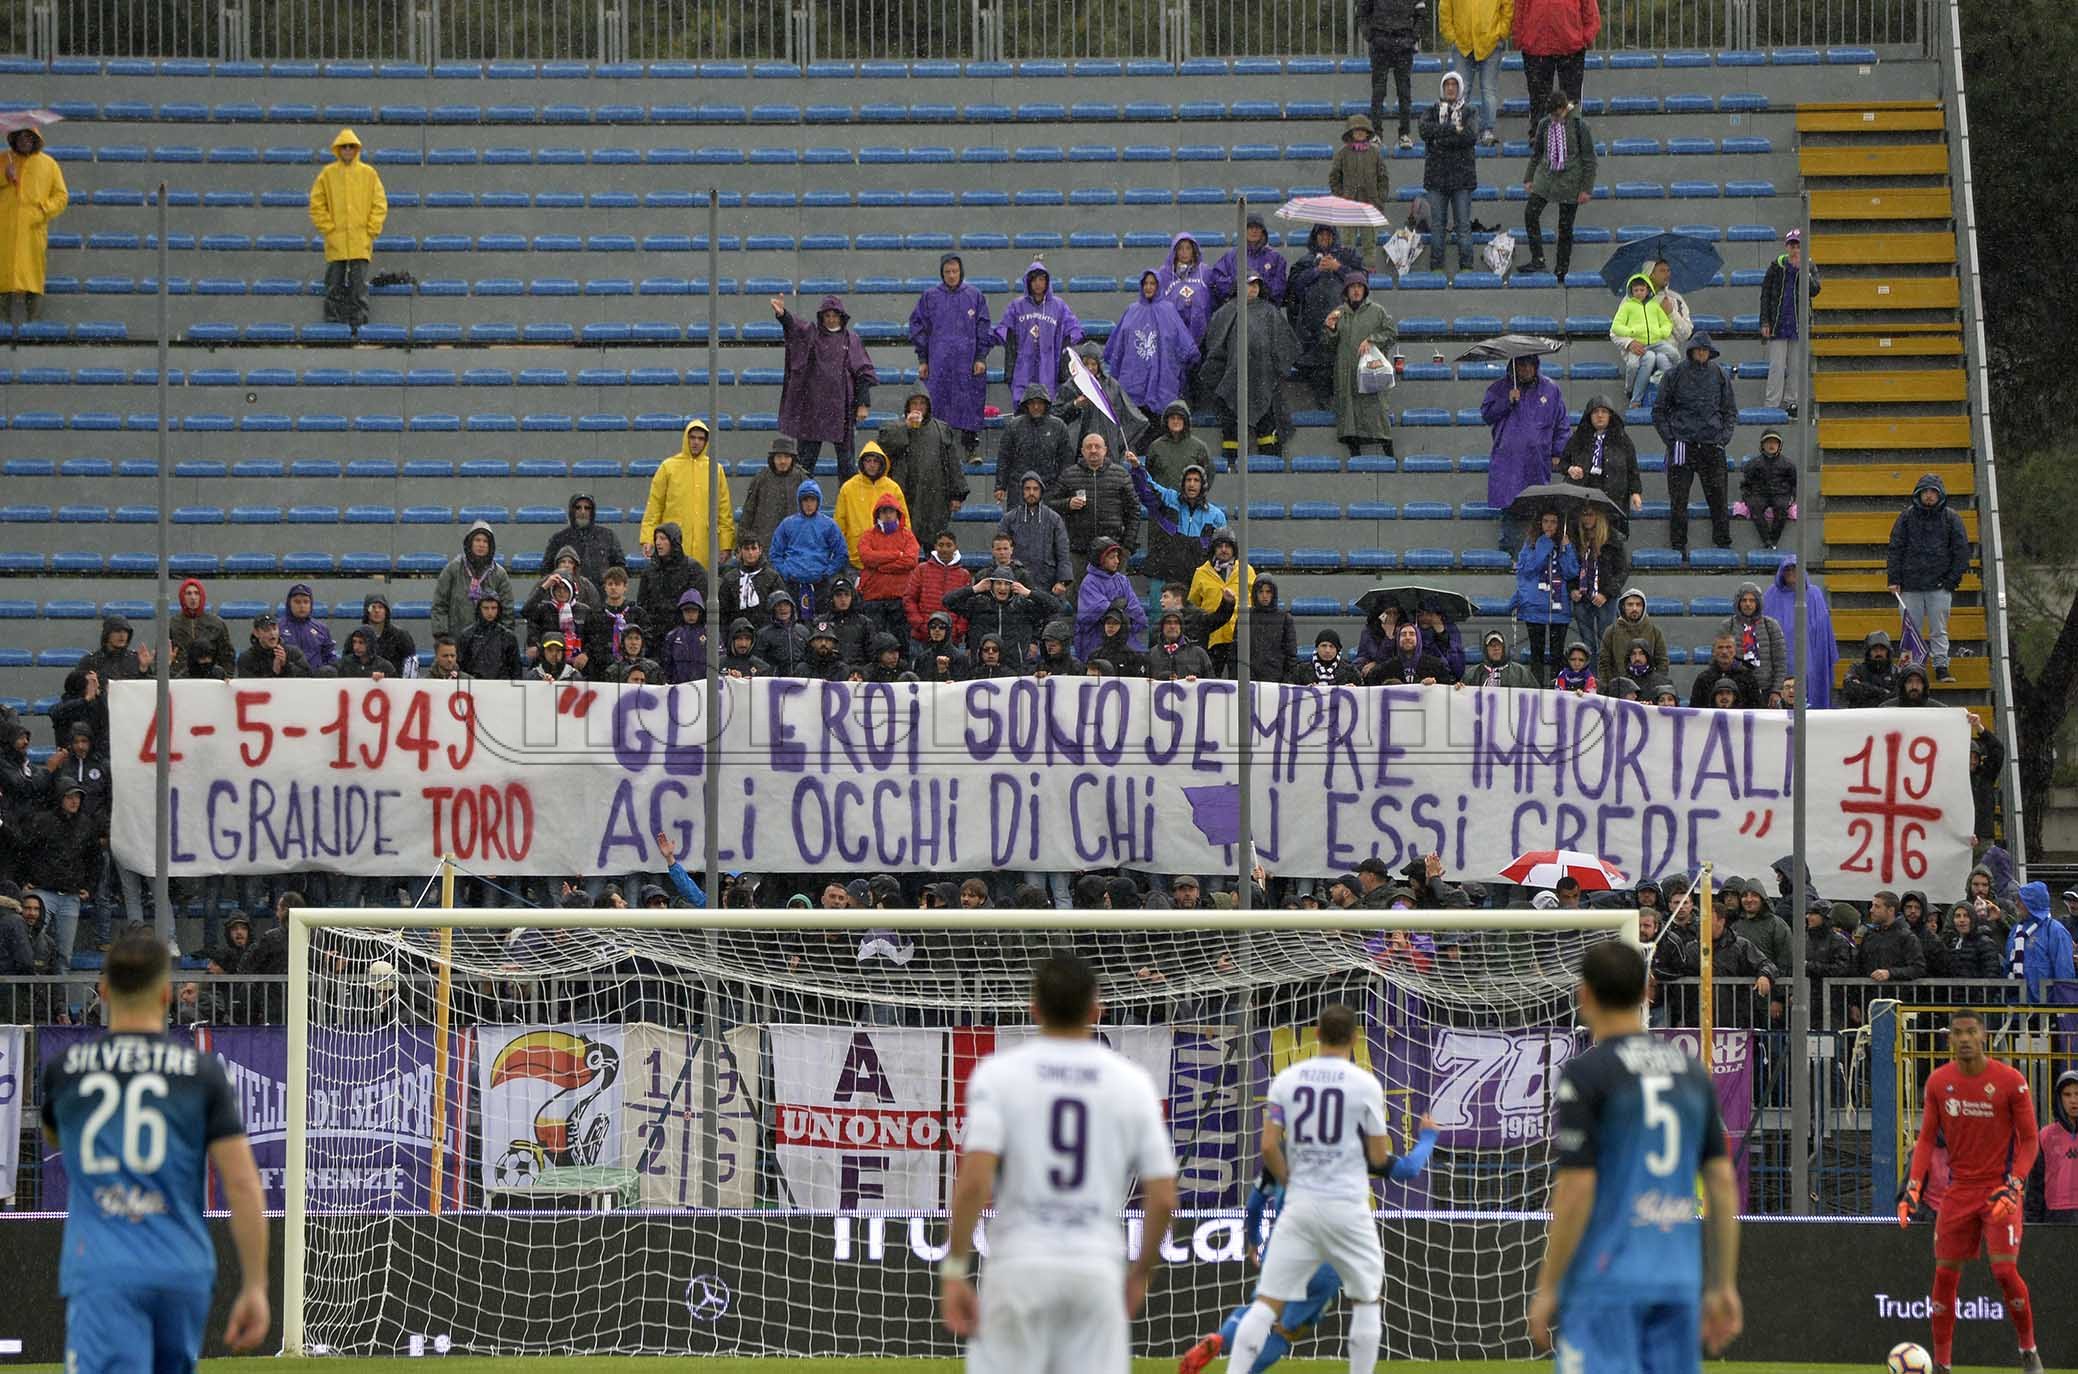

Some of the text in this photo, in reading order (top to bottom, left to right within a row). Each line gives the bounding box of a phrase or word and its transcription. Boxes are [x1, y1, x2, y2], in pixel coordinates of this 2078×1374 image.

[964, 679, 1130, 767] SONO
[1144, 681, 1424, 791] SEMPRE
[207, 779, 402, 862] GRANDE
[422, 783, 535, 862] TORO
[63, 1041, 198, 1077] SILVESTRE
[78, 1072, 169, 1175] 26
[1049, 1097, 1087, 1192] 9
[1293, 1086, 1344, 1145] 20
[1641, 1075, 1681, 1177] 5
[1954, 1296, 2004, 1320] talia
